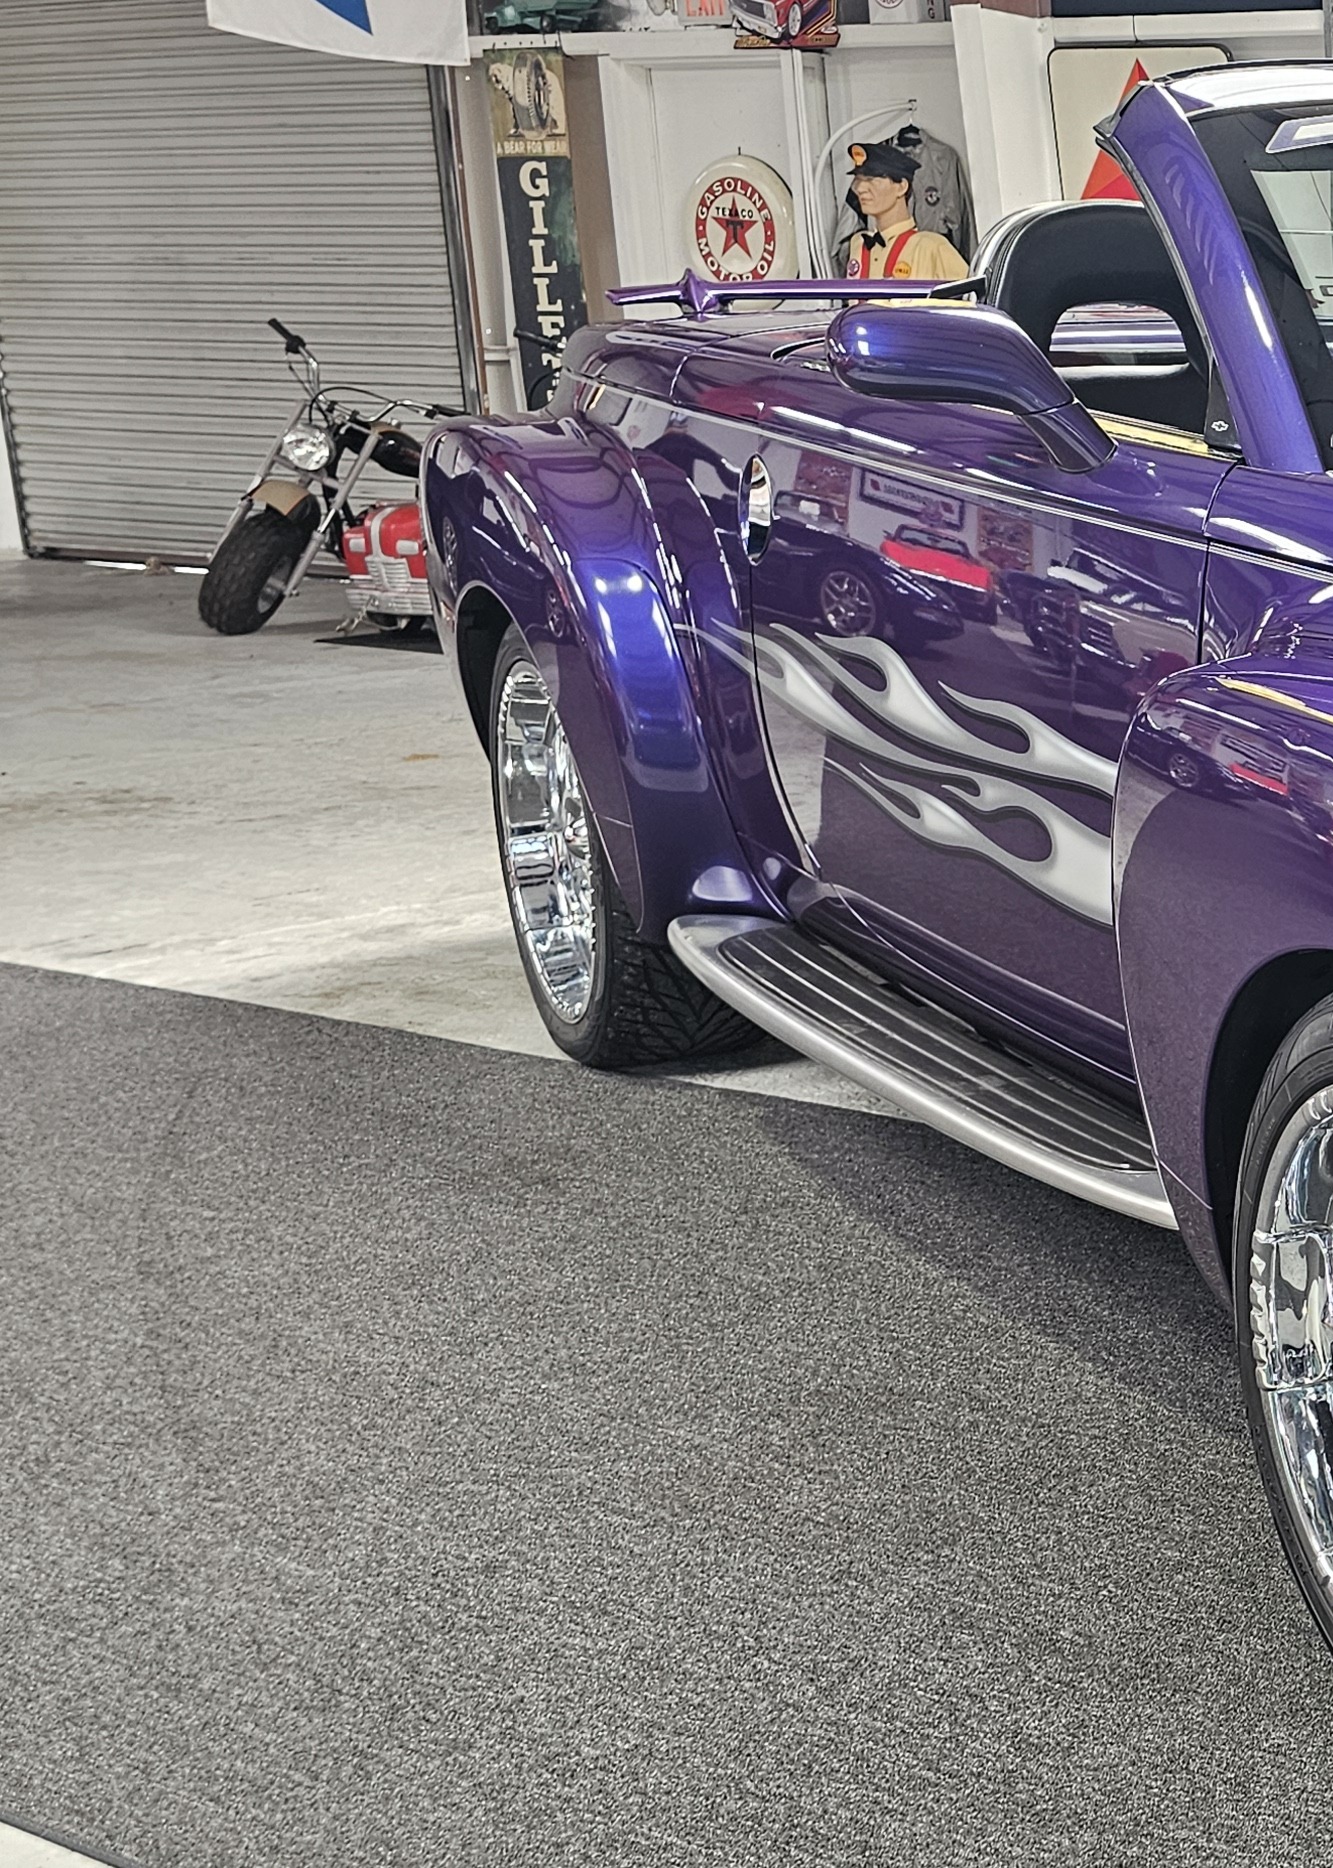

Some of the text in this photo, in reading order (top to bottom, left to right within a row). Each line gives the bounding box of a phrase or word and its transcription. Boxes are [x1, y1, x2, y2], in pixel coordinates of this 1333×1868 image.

[503, 141, 526, 154] BEAR
[526, 141, 543, 154] FOR
[698, 178, 771, 221] GASOLINE
[715, 207, 754, 219] TEXACO
[698, 238, 753, 281] MOTOR
[757, 241, 774, 275] OIL
